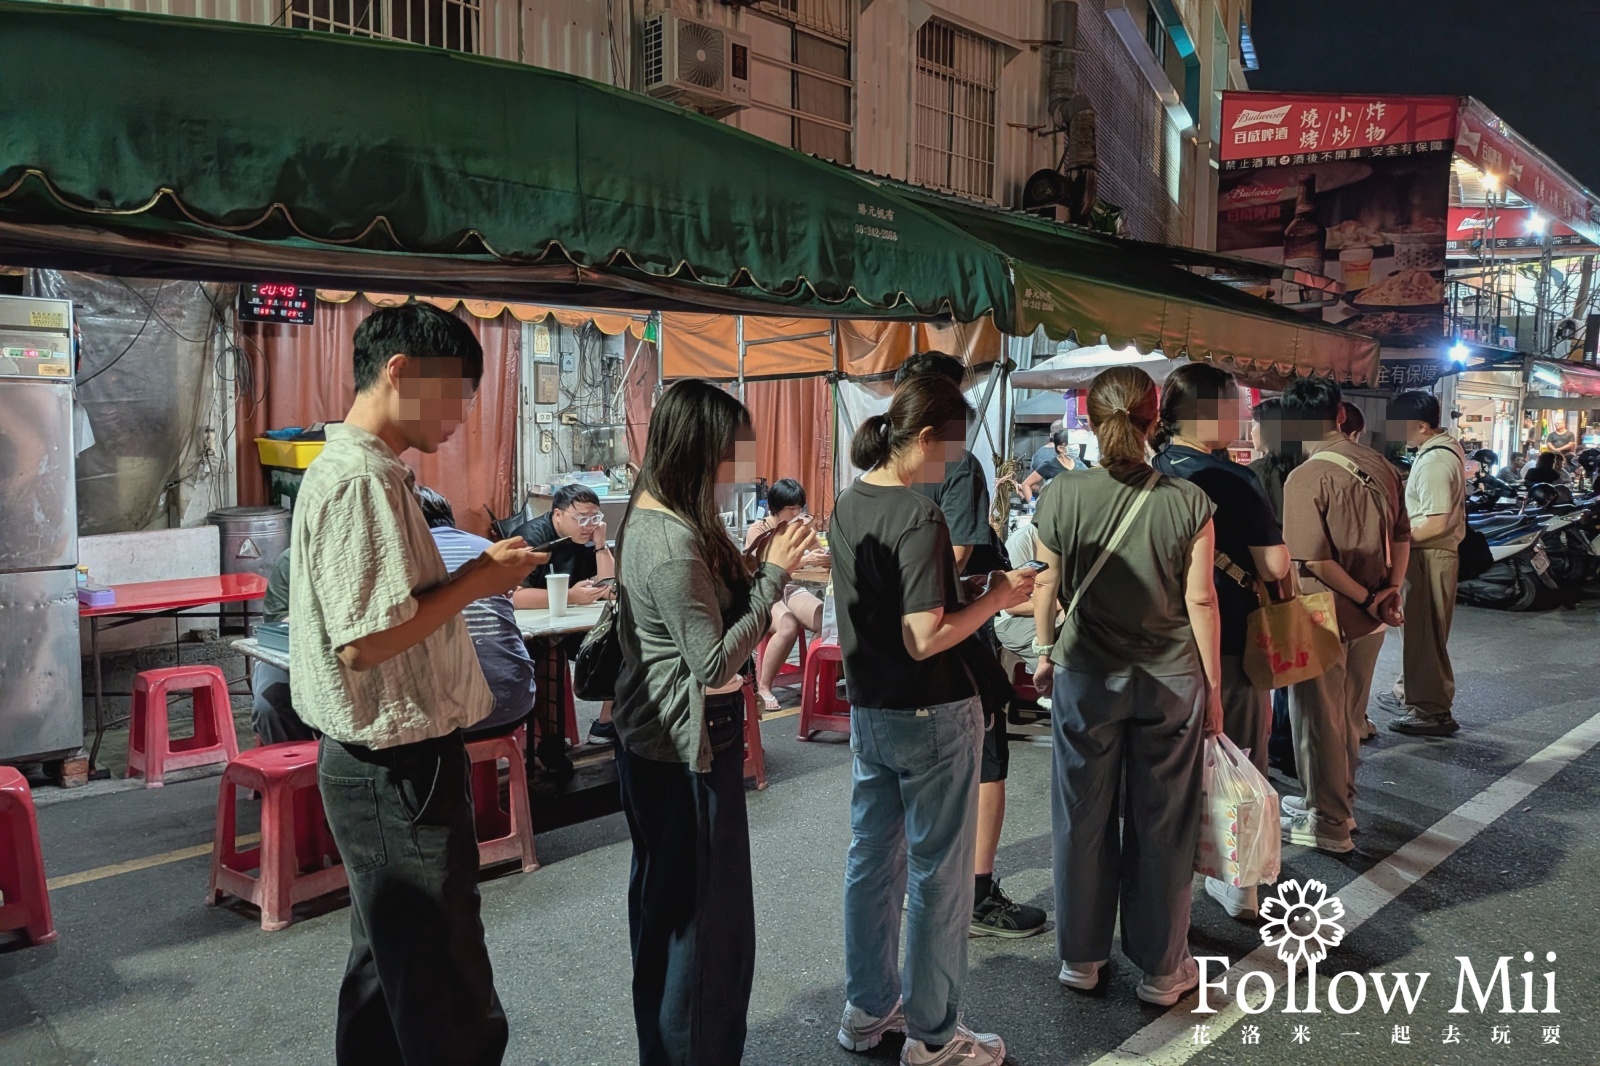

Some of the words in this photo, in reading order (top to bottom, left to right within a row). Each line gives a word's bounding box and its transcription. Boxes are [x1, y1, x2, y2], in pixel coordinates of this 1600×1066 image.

[1237, 109, 1287, 123] Budweiser
[1299, 108, 1322, 149] 燒烤
[1332, 106, 1352, 147] 小炒
[1365, 101, 1386, 143] 炸物
[1234, 127, 1288, 144] 百威啤酒
[1225, 157, 1277, 170] 禁止酒駕
[1292, 148, 1361, 165] 酒後不開車
[1371, 141, 1443, 157] 安全有保障
[1230, 187, 1283, 199] Budweiser
[260, 285, 295, 297] 20:49
[1363, 364, 1438, 384] 全有保障
